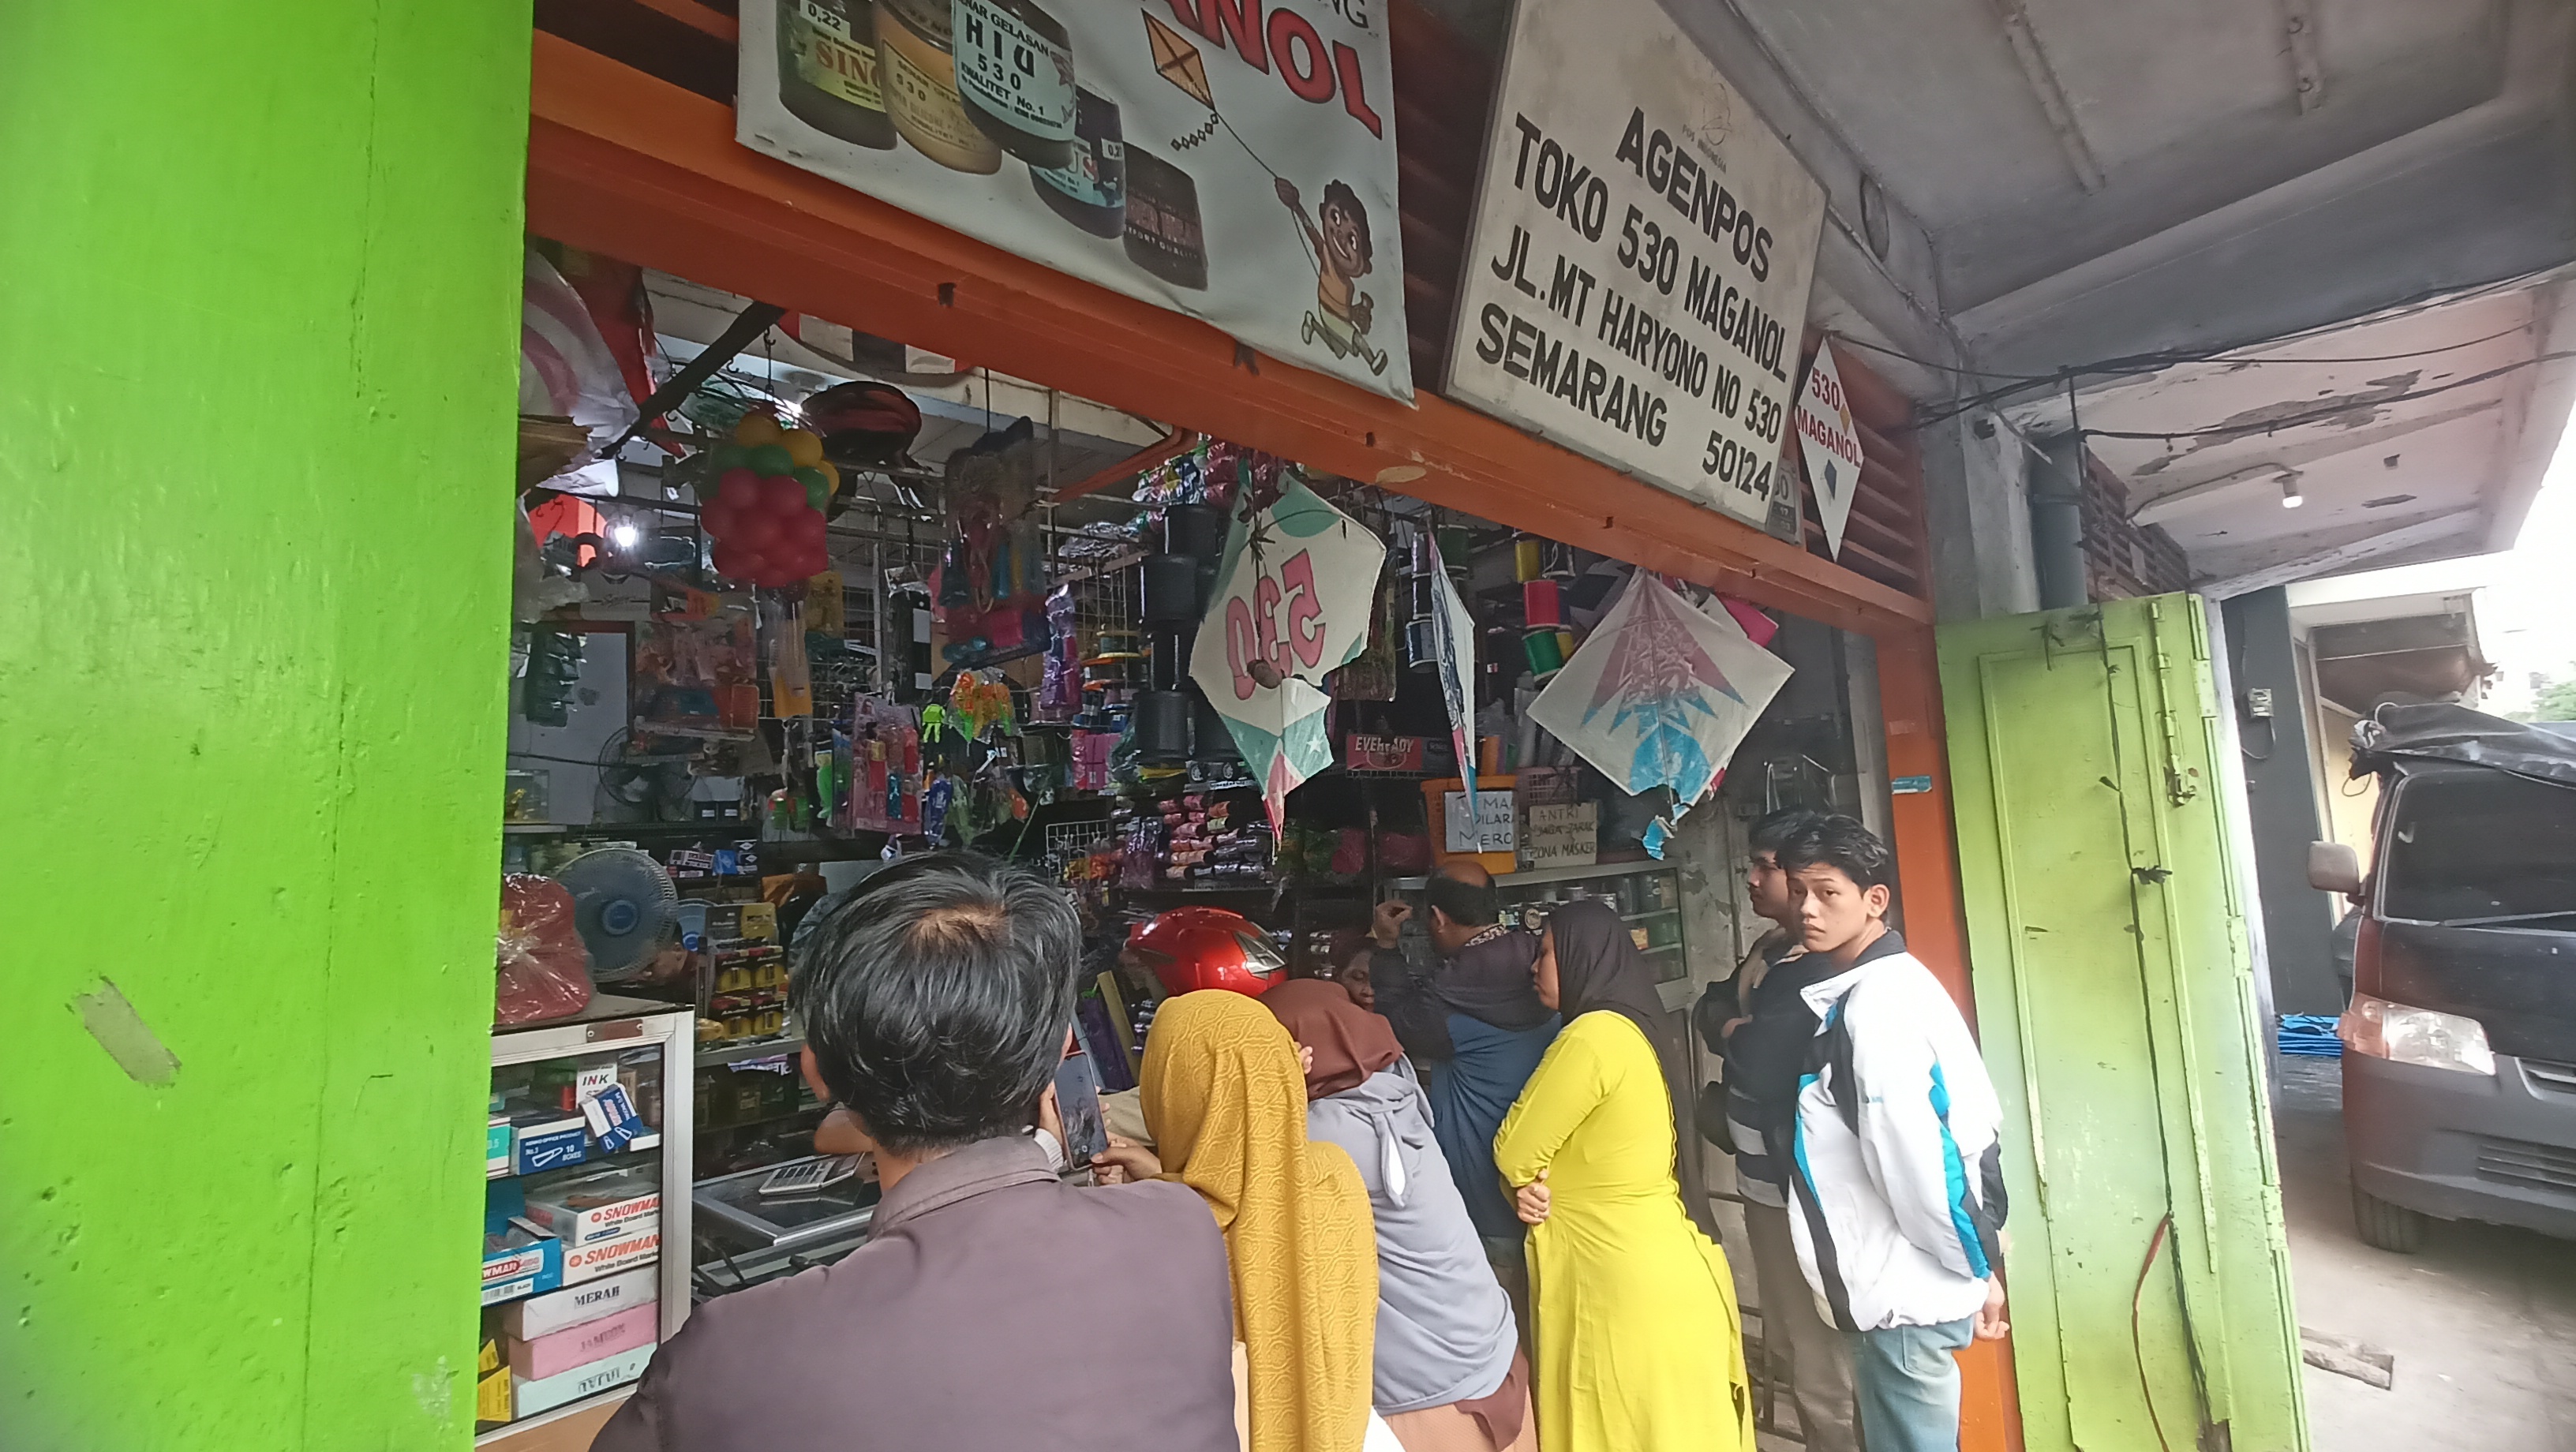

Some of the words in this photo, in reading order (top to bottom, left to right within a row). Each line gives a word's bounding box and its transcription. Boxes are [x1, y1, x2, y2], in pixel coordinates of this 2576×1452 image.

[807, 3, 842, 32] 0,22
[990, 13, 1049, 57] GELASAN
[966, 13, 1035, 77] HIU
[961, 62, 1011, 100] KWALITET
[978, 53, 1021, 91] 530
[1616, 106, 1773, 283] AGENPOS
[1515, 111, 1608, 243] TOKO
[1617, 204, 1679, 295] 530
[1684, 255, 1786, 384] MAGANOL
[1476, 302, 1668, 447] SEMARANG
[1597, 288, 1708, 398] HARYONO
[1711, 365, 1741, 419] NO
[1744, 388, 1781, 443] 530
[1812, 366, 1840, 411] 530
[1797, 405, 1861, 469] MAGANOL
[1702, 429, 1772, 502] 50124
[1539, 808, 1579, 821] ANTRI
[582, 1073, 609, 1087] INK
[562, 1151, 582, 1162] BOXES
[566, 1144, 575, 1153] 10
[623, 1213, 643, 1222] Board
[594, 1263, 616, 1272] White
[616, 1256, 638, 1267] Board
[575, 1285, 620, 1306] MERAH
